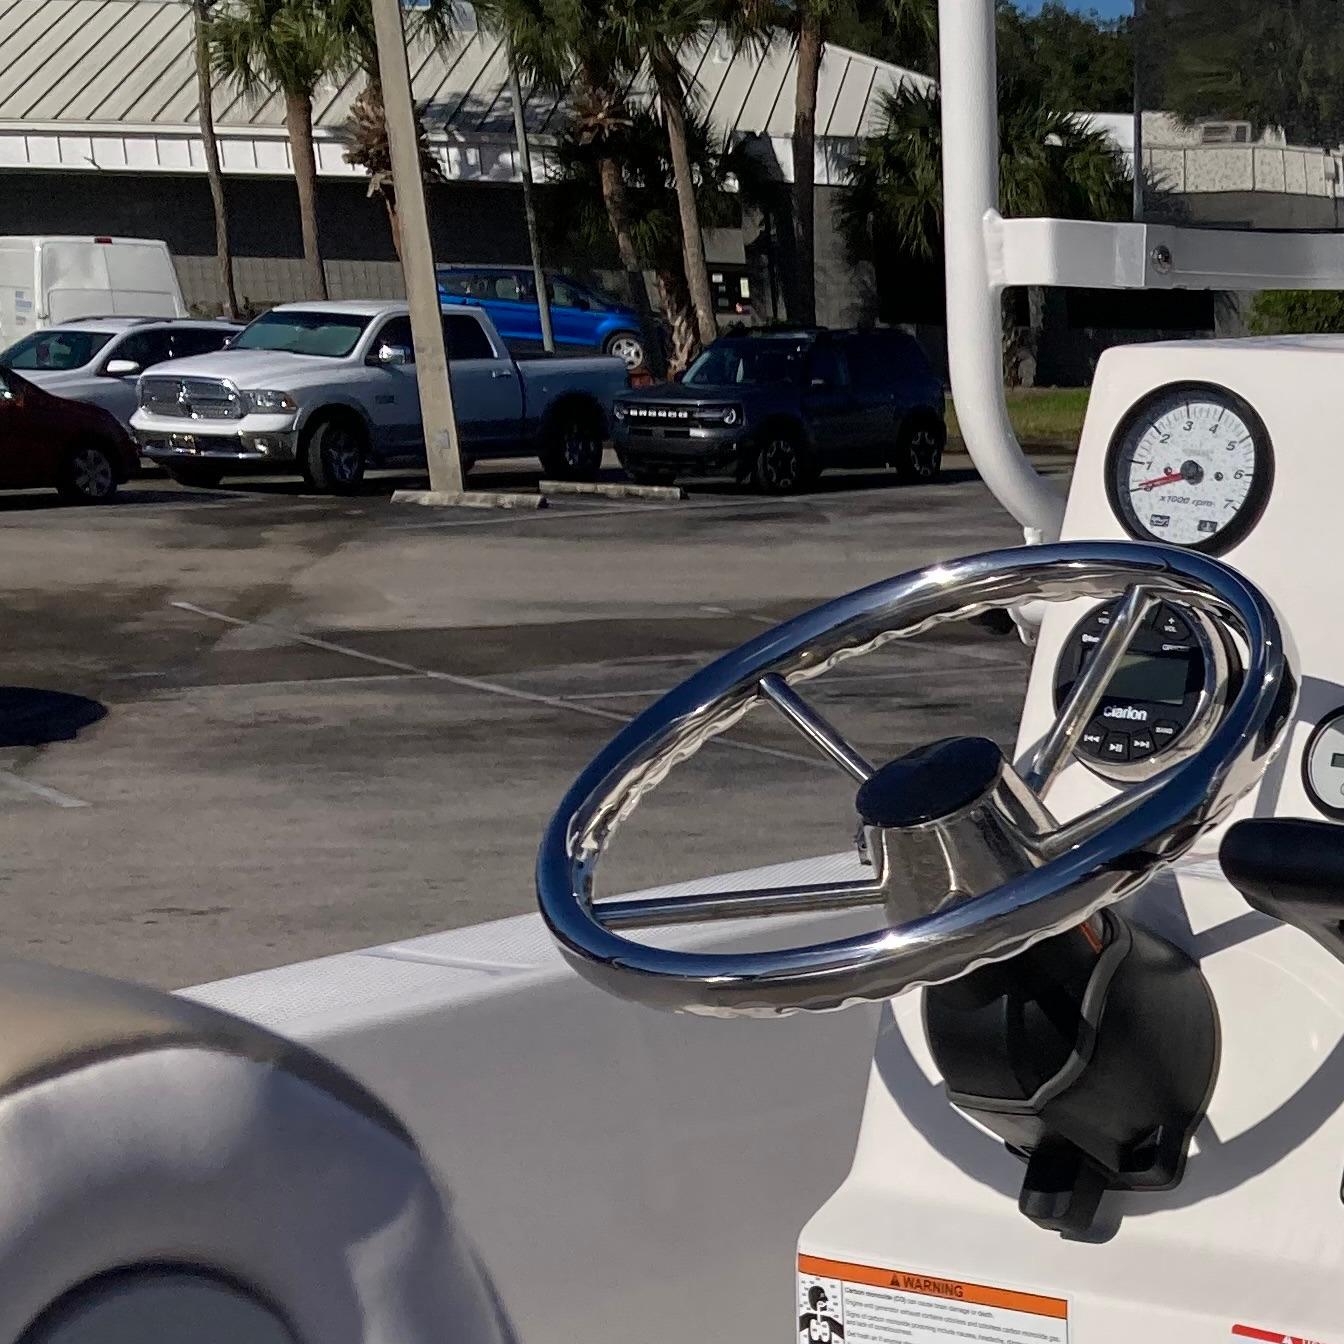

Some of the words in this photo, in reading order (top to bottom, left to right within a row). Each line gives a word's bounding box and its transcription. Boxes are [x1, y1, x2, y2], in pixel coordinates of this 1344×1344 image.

[1183, 420, 1194, 432] 3
[1209, 423, 1219, 434] 4
[1160, 434, 1171, 444] 2
[1226, 441, 1238, 452] 5
[1234, 469, 1245, 480] 6
[1224, 499, 1234, 509] 7
[902, 1275, 963, 1298] WARNING
